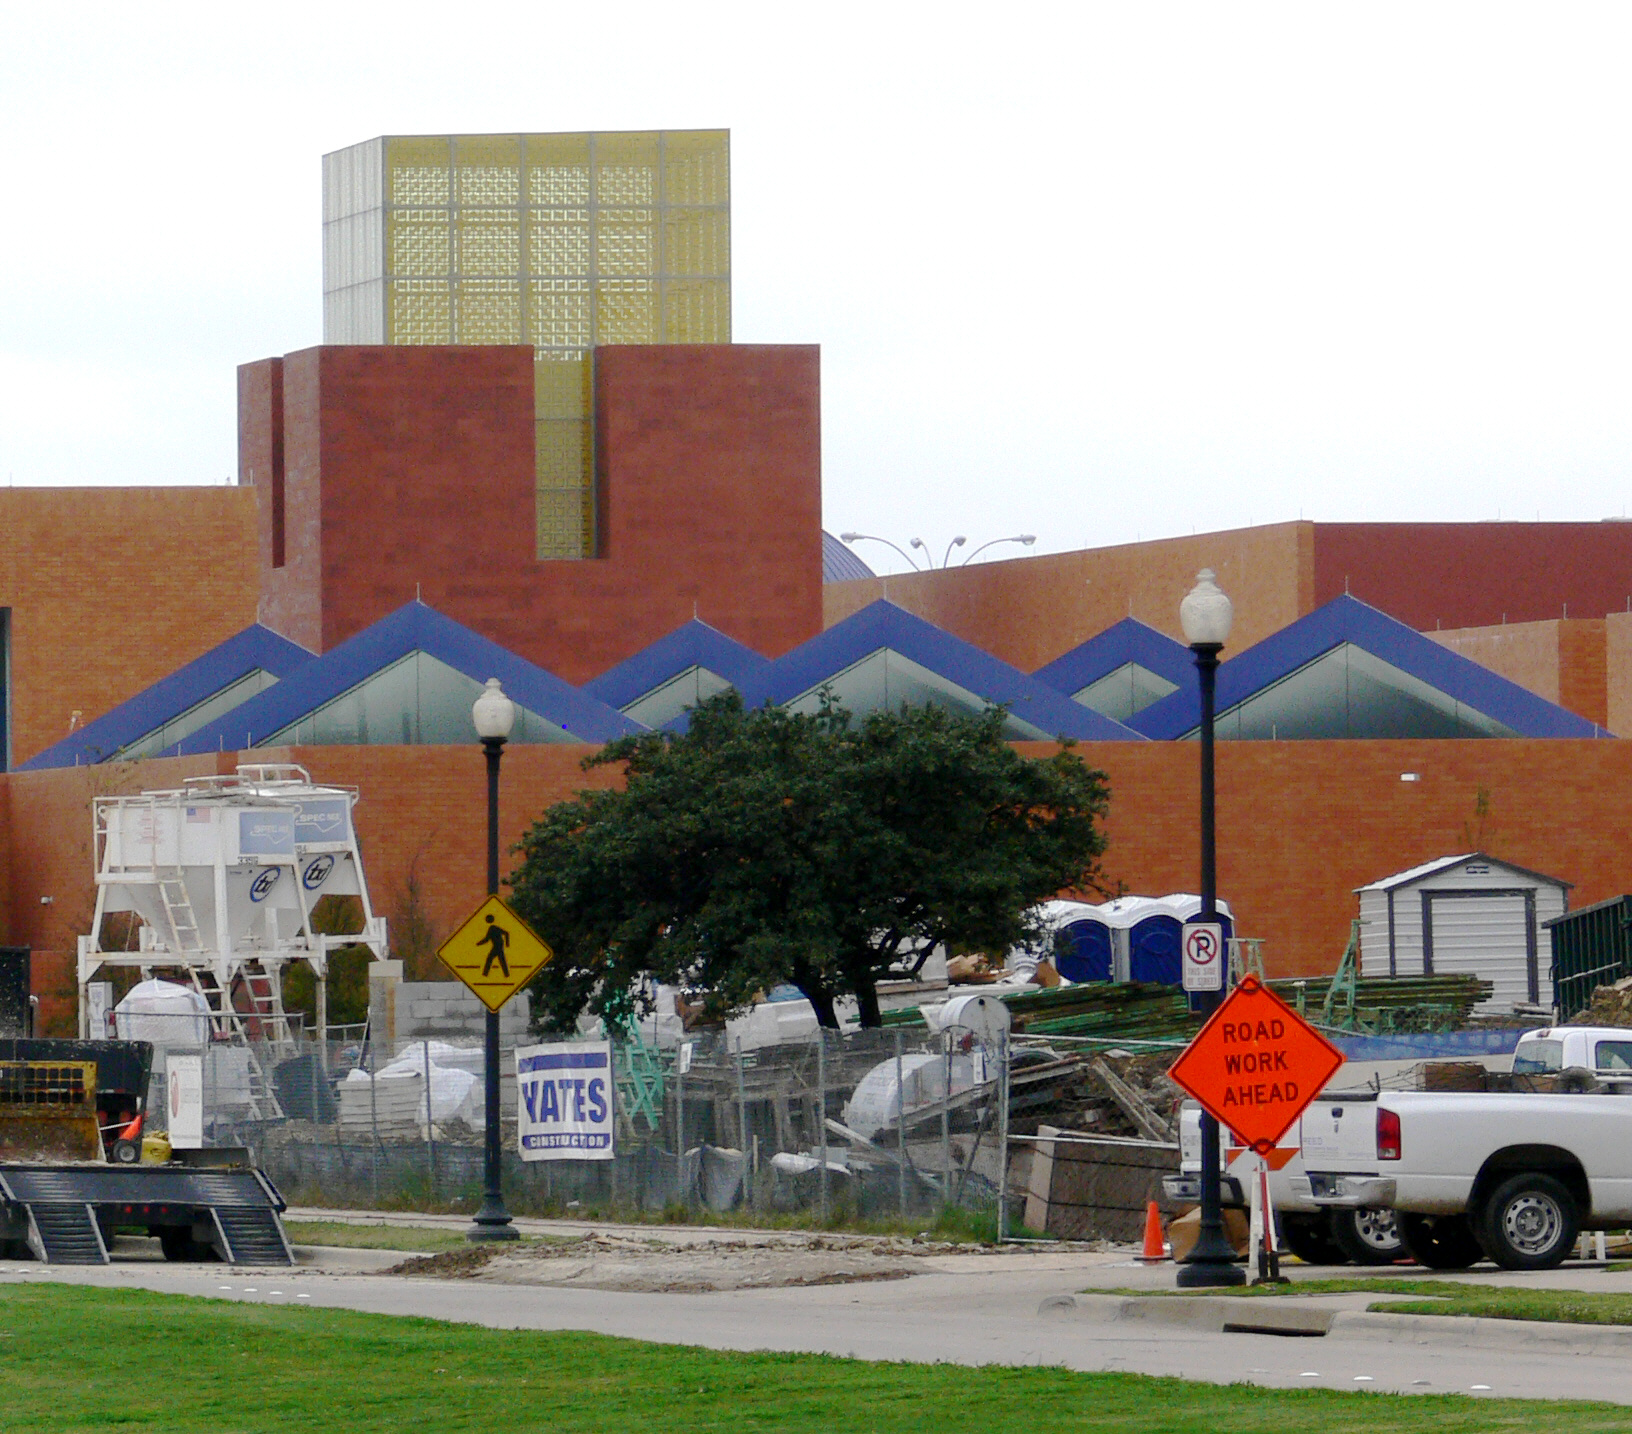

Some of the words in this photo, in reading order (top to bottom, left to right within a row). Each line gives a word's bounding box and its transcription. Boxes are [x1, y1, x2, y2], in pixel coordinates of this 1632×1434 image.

[1222, 1019, 1285, 1044] ROAD
[1224, 1050, 1288, 1075] WORK
[521, 1077, 607, 1123] YATES
[1223, 1081, 1299, 1107] AHEAD
